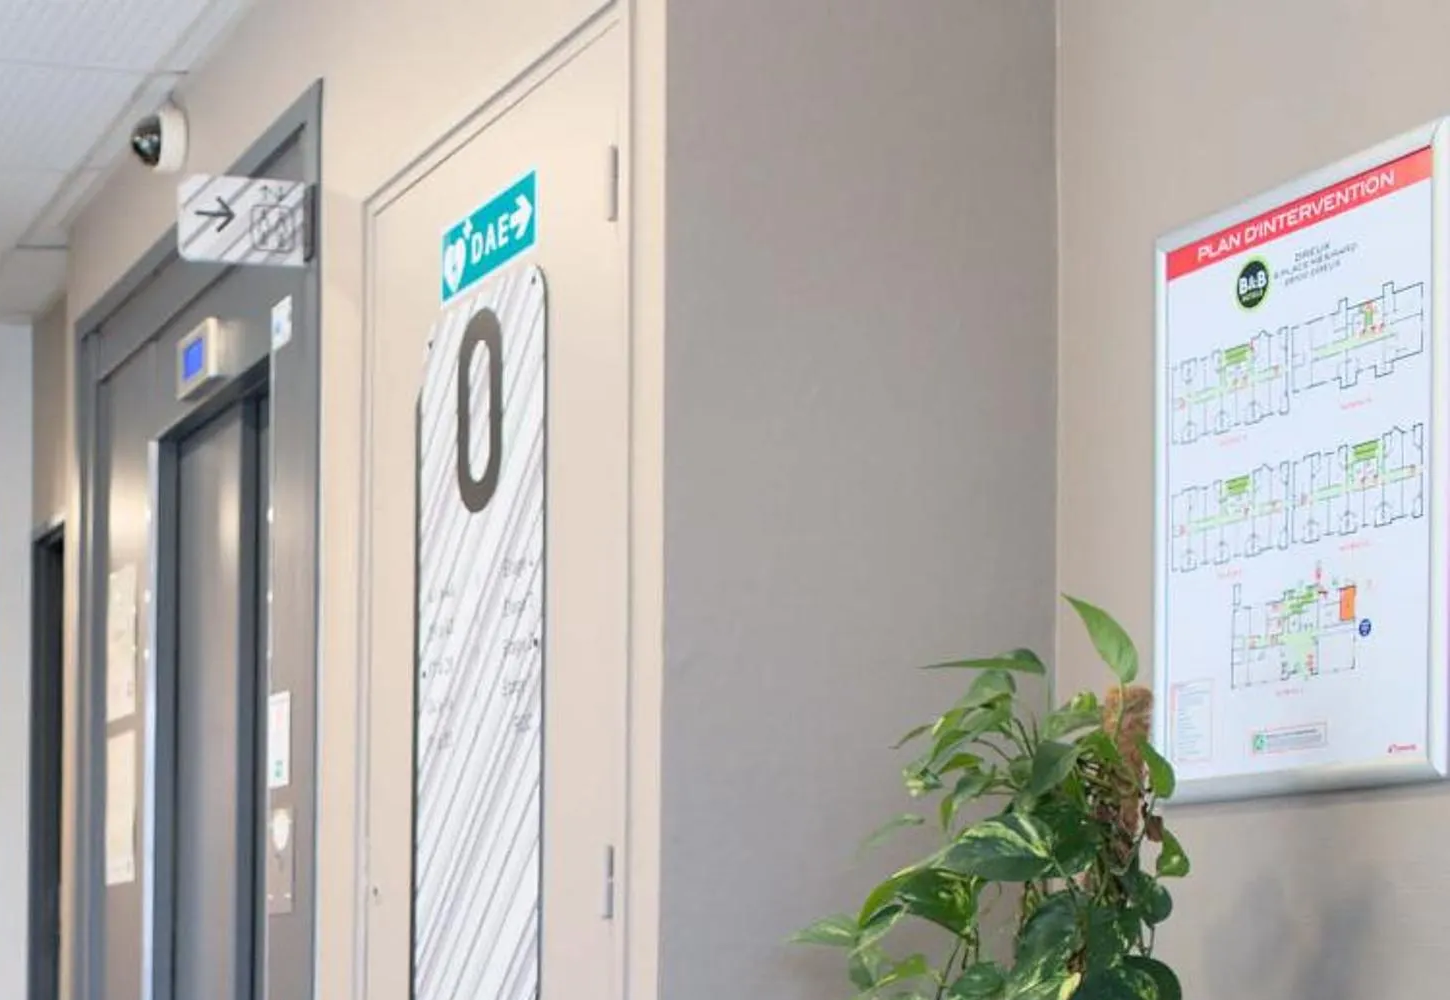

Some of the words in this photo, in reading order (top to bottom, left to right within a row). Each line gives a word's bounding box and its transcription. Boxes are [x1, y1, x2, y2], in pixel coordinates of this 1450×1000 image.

[470, 213, 509, 264] DAE
[1198, 234, 1241, 261] PLAN
[1245, 170, 1395, 243] D'INTERVENTION
[457, 308, 502, 513] 0
